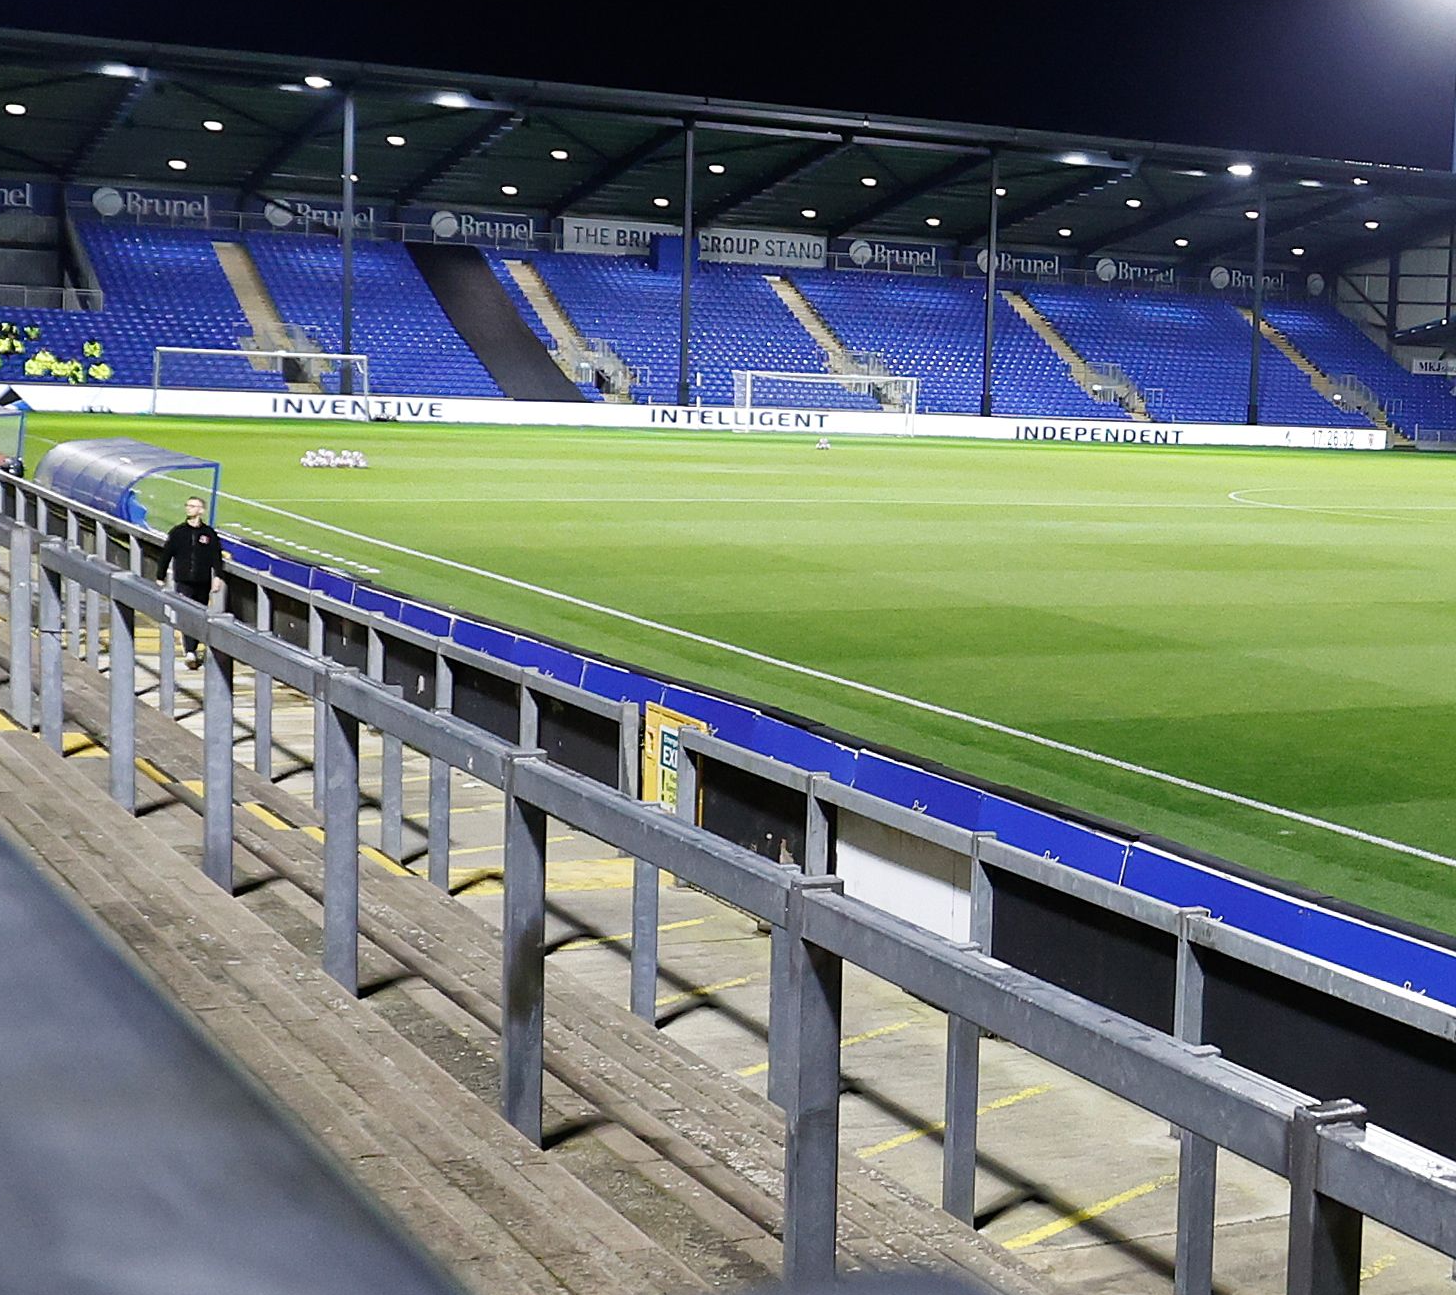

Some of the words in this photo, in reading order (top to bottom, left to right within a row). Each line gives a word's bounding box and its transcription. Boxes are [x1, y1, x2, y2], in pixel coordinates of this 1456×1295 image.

[125, 191, 210, 218] Brunel
[460, 213, 534, 241] Brunel
[573, 225, 609, 247] THE
[764, 239, 824, 261] STAND
[873, 242, 936, 266] Brunel
[1000, 252, 1059, 276] Brunel
[1116, 260, 1175, 284] Brunel
[1419, 362, 1442, 372] MKJ
[271, 397, 444, 419] INVENTIVE
[650, 408, 830, 429] INTELLIGENT
[1015, 425, 1185, 445] INDEPENDENT
